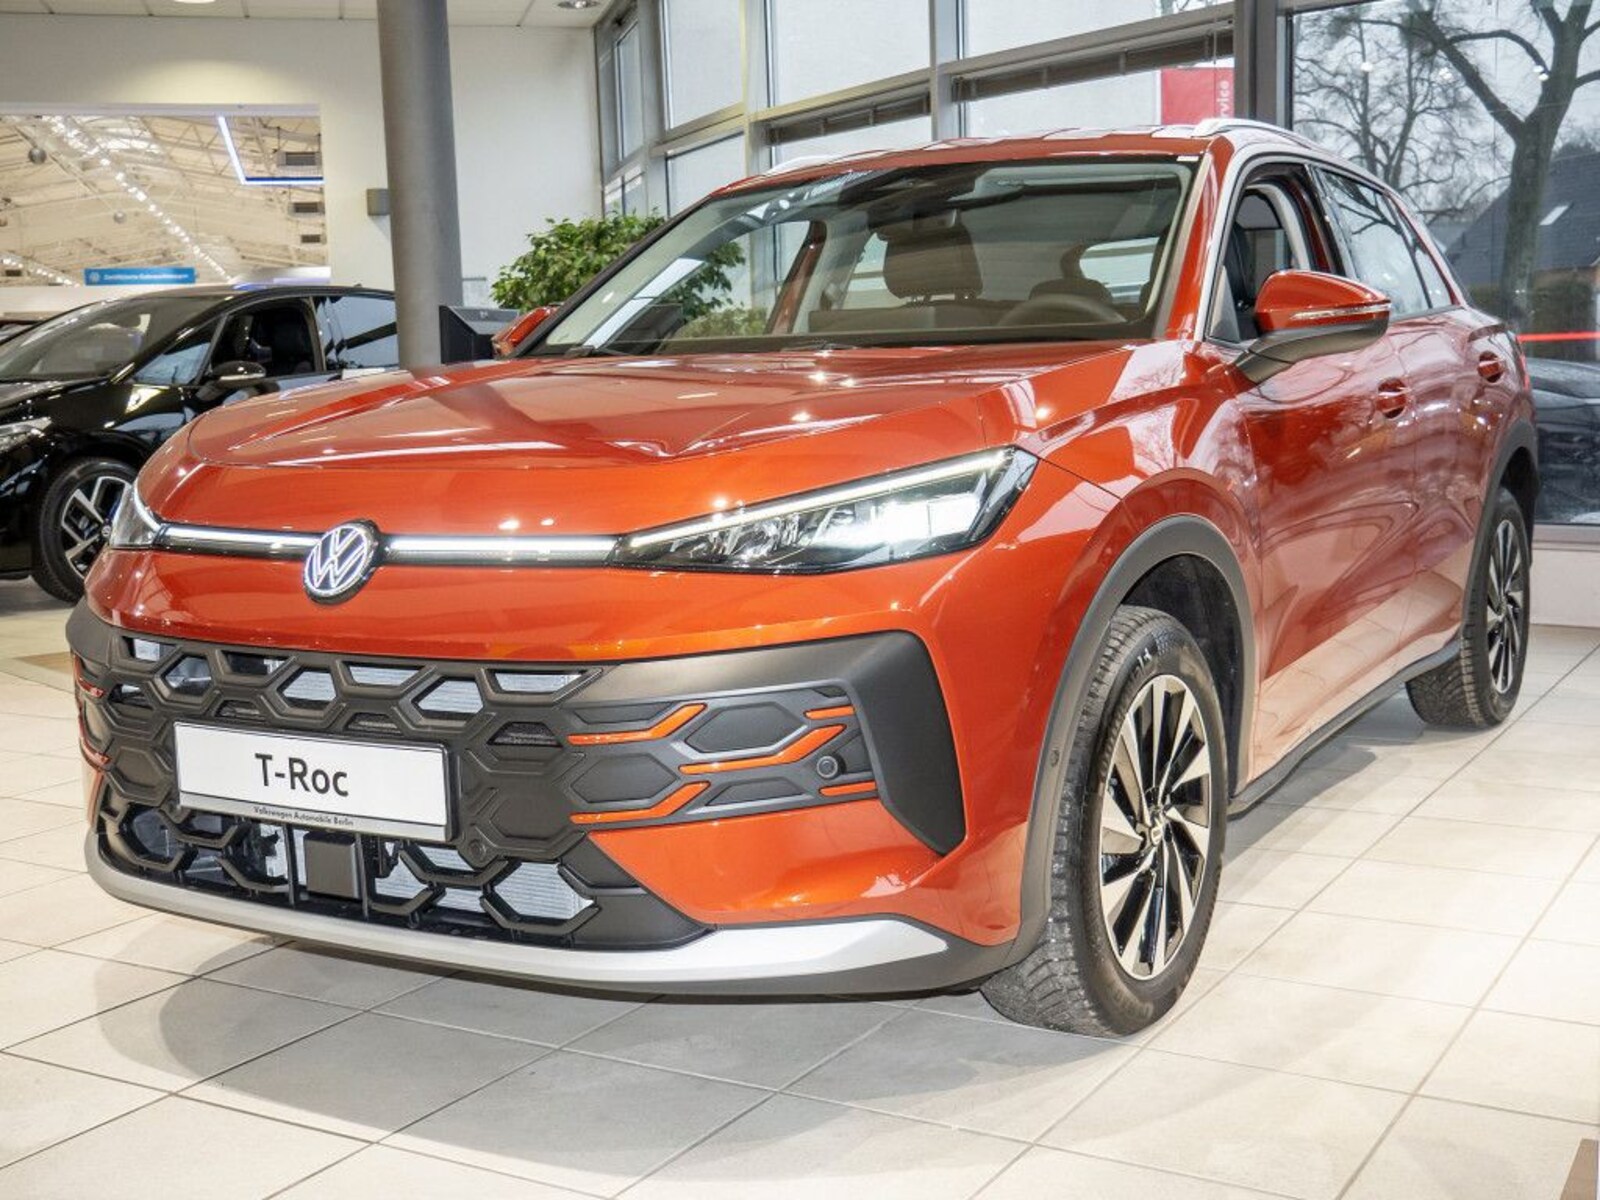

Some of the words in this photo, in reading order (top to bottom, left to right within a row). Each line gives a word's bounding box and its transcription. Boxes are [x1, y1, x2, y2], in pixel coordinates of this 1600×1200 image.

[1216, 80, 1230, 117] rvice
[254, 753, 349, 797] T-Roc
[253, 806, 293, 819] Volkswagen
[294, 812, 332, 823] Automobile
[333, 816, 354, 826] Berlin
